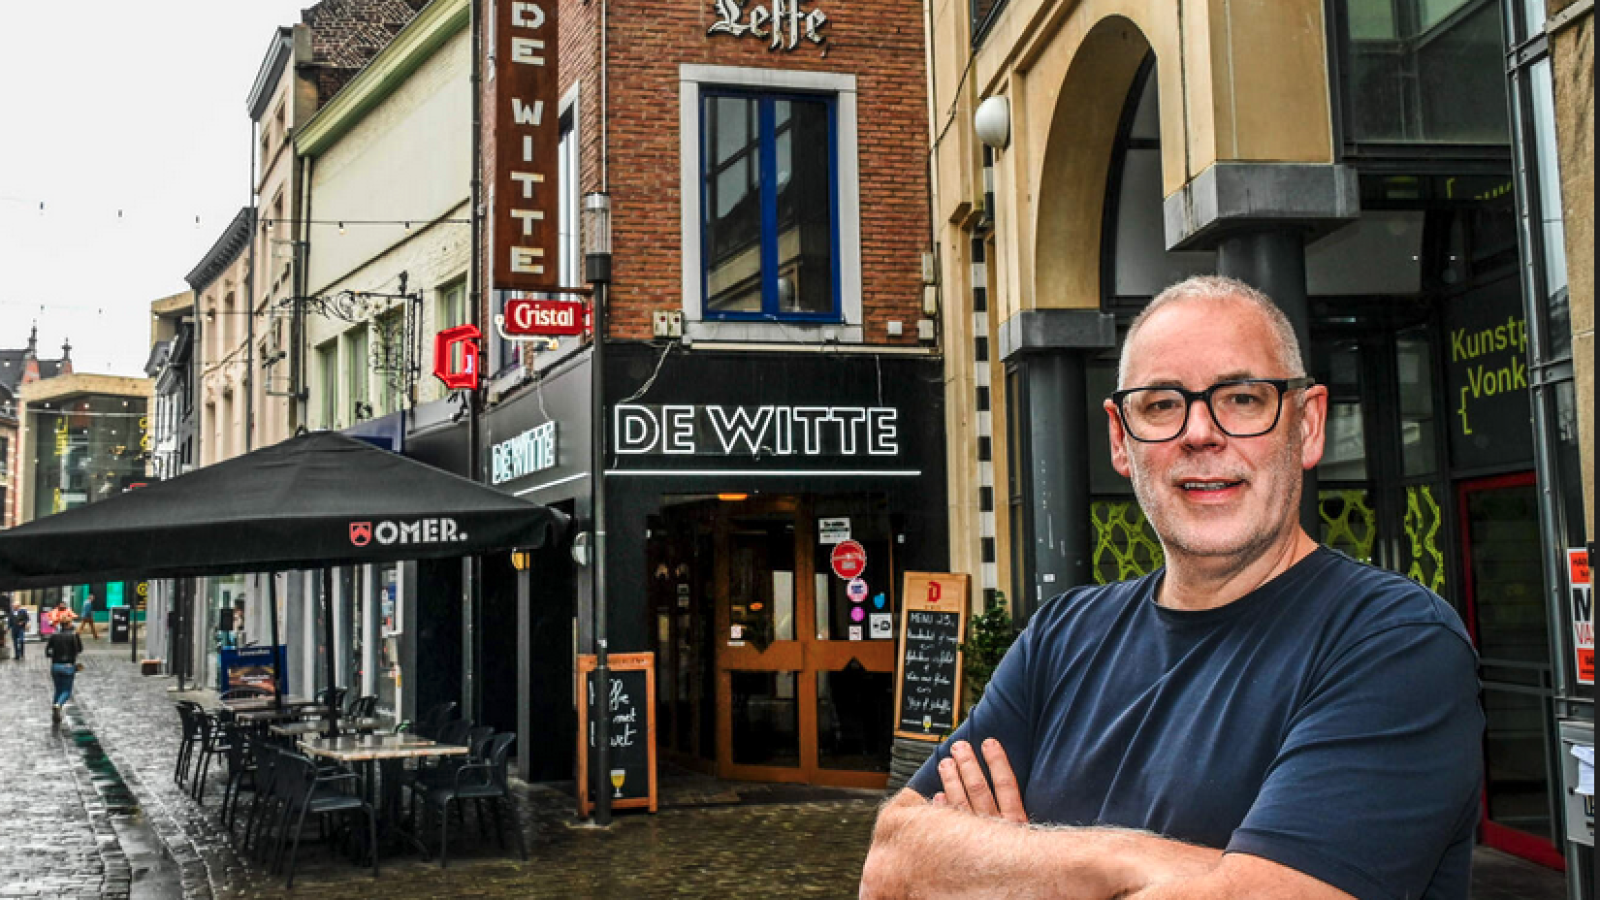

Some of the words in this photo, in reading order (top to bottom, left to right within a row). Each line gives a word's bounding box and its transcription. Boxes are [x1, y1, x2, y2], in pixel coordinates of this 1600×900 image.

[511, 1, 545, 67] DE
[707, 0, 827, 49] Leffe
[510, 98, 545, 274] WITTE
[514, 303, 575, 329] Cristal
[1467, 355, 1527, 398] Vonk
[492, 439, 512, 485] DE
[511, 421, 556, 479] WITTE
[614, 405, 695, 454] DE
[705, 405, 899, 455] WITTE
[373, 516, 468, 544] OMER.
